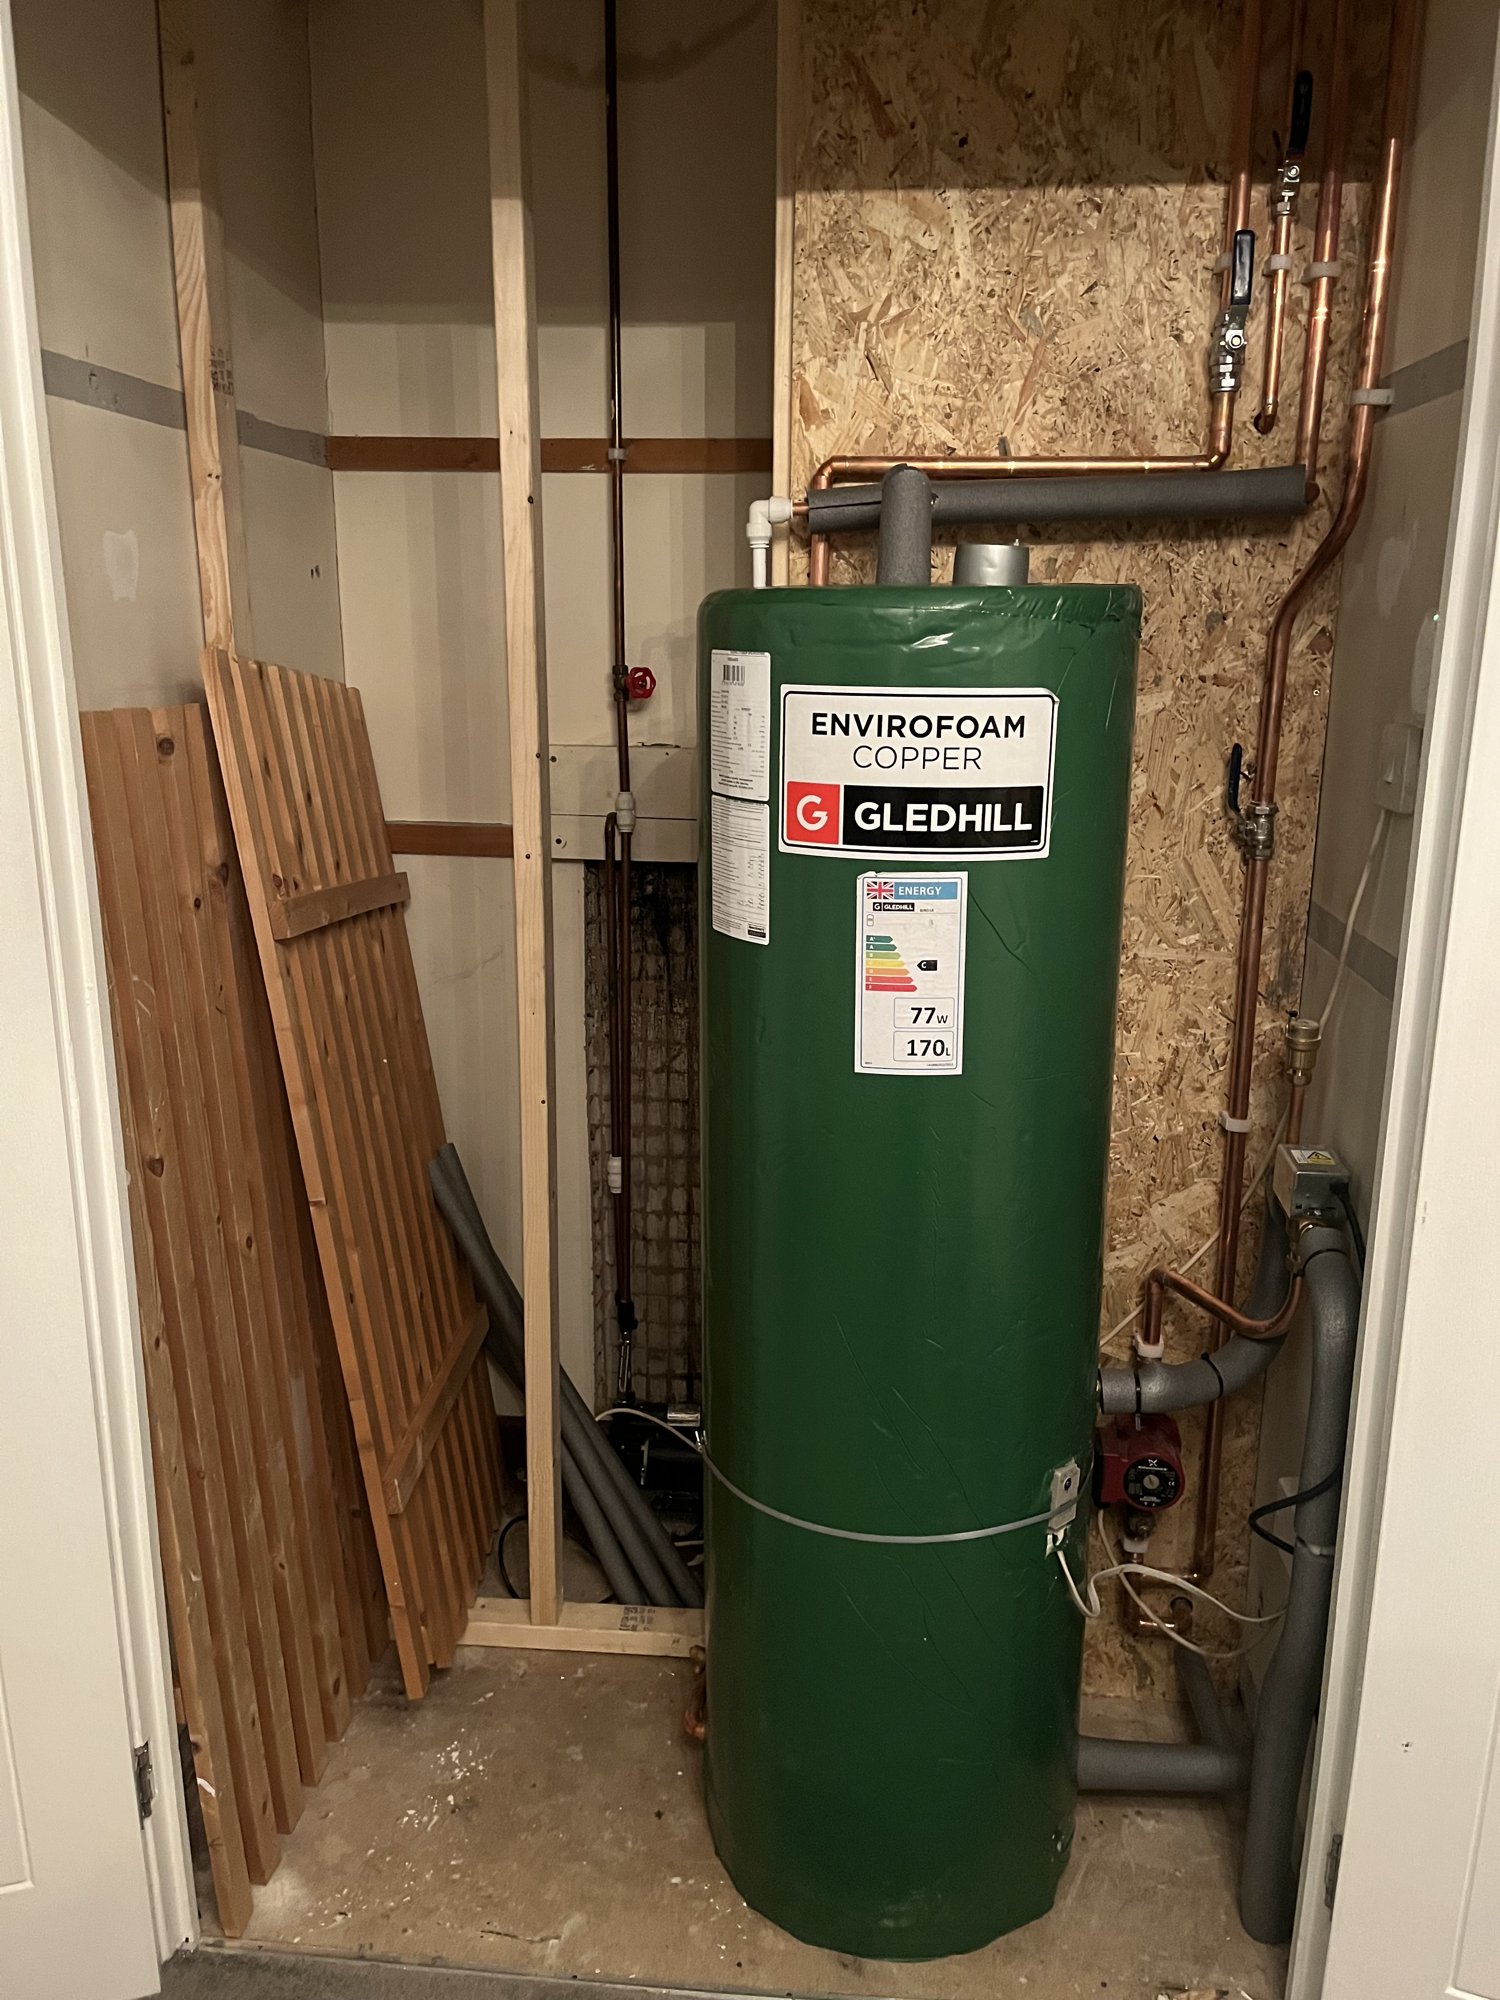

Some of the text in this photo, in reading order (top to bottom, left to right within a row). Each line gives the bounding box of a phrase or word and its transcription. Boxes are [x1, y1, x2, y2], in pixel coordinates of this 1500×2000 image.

[811, 712, 1025, 739] ENVIROFOAM
[853, 745, 982, 770] COPPER
[796, 794, 1033, 832] G GLEDHILL
[898, 886, 942, 896] ENERGY
[921, 961, 927, 969] C
